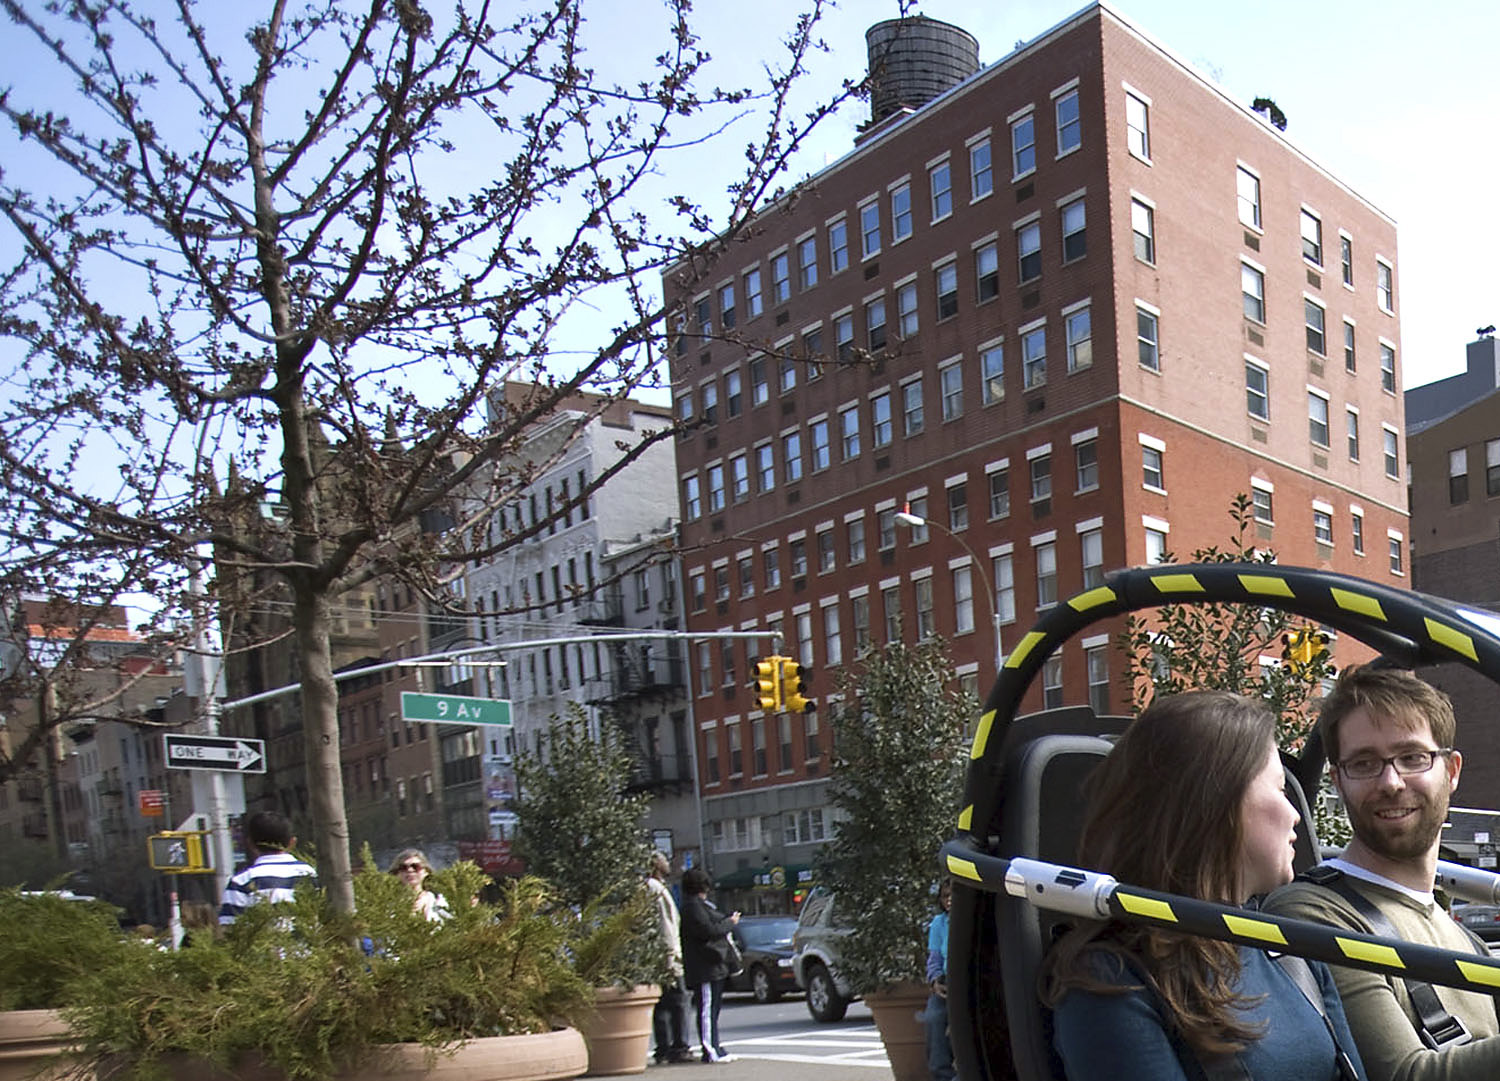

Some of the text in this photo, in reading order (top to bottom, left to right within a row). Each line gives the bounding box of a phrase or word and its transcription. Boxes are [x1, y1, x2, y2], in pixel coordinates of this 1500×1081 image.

[436, 701, 481, 718] 9 Av
[175, 746, 253, 760] ONE WAY
